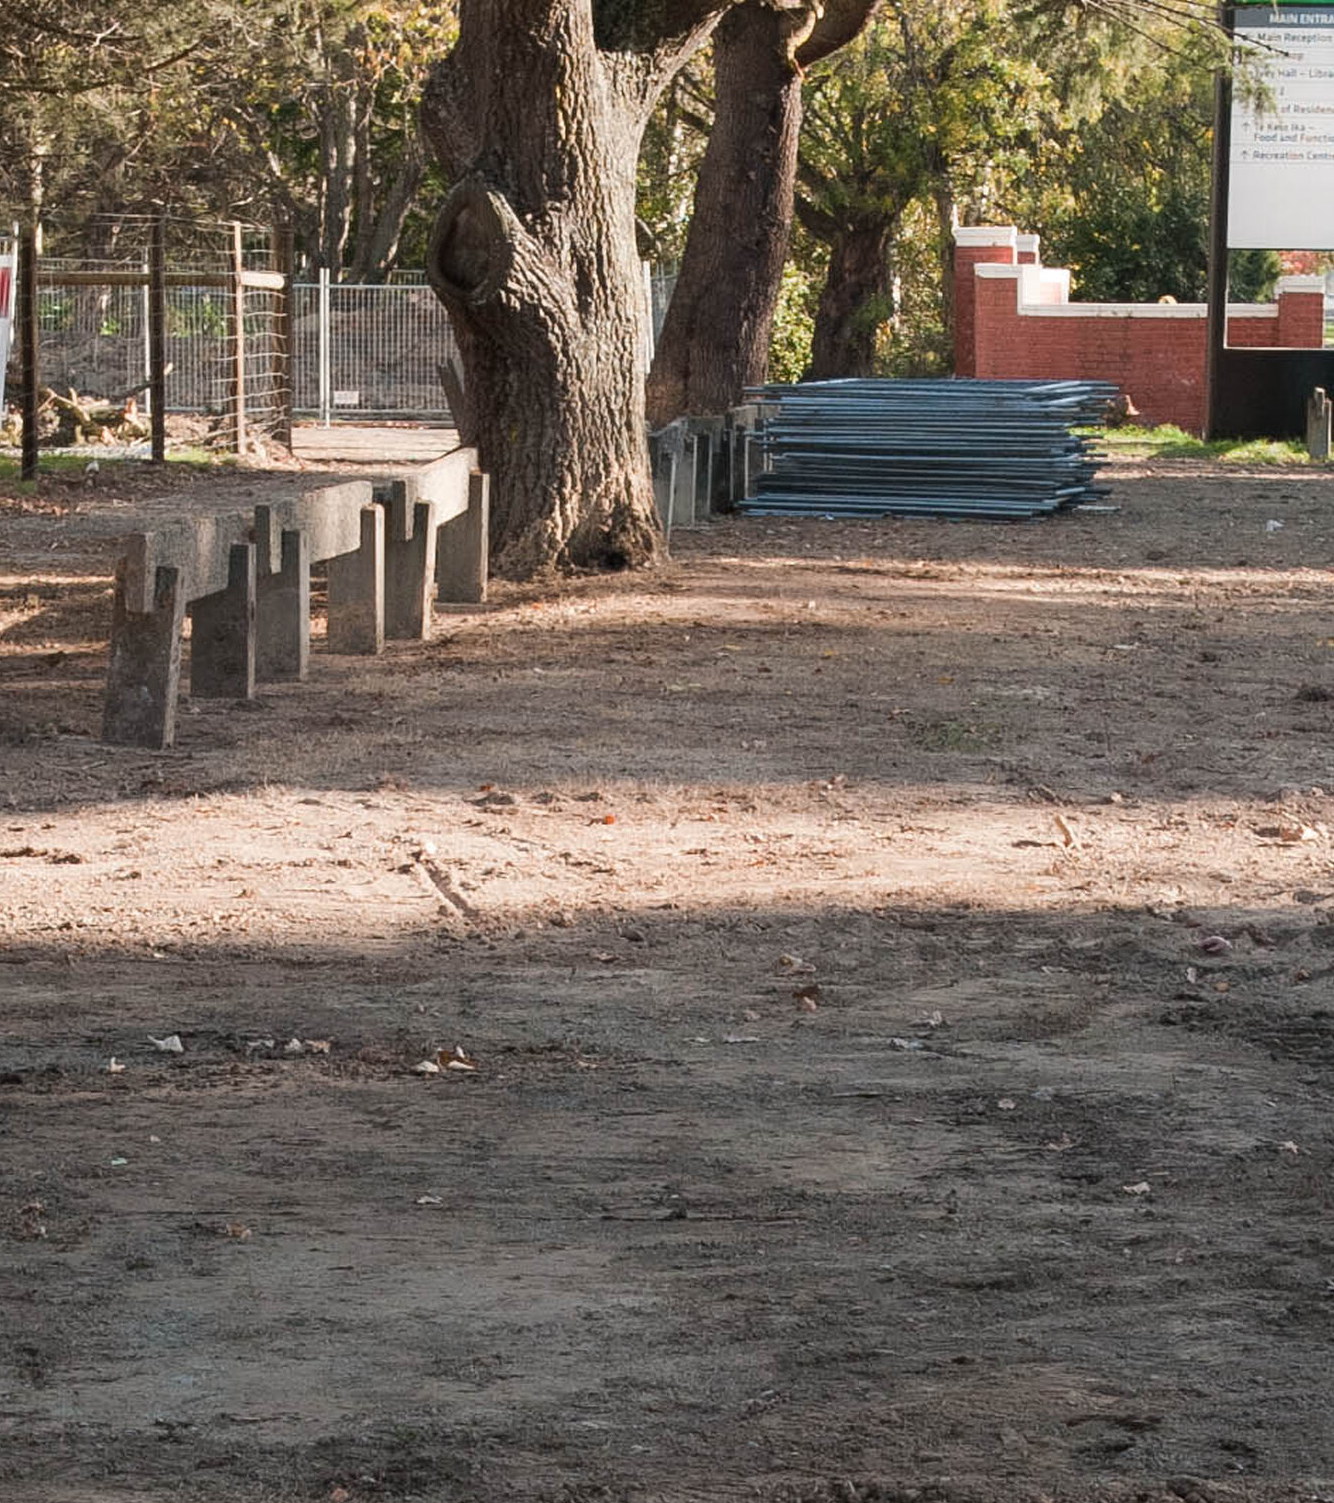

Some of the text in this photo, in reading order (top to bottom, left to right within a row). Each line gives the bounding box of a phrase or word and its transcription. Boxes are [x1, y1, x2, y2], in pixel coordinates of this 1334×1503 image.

[1269, 13, 1298, 25] MAIN
[1257, 33, 1333, 44] Main Reception
[1278, 68, 1297, 77] Hall
[1254, 132, 1278, 142] Food
[1280, 133, 1298, 142] and
[1252, 149, 1304, 160] Recreation
